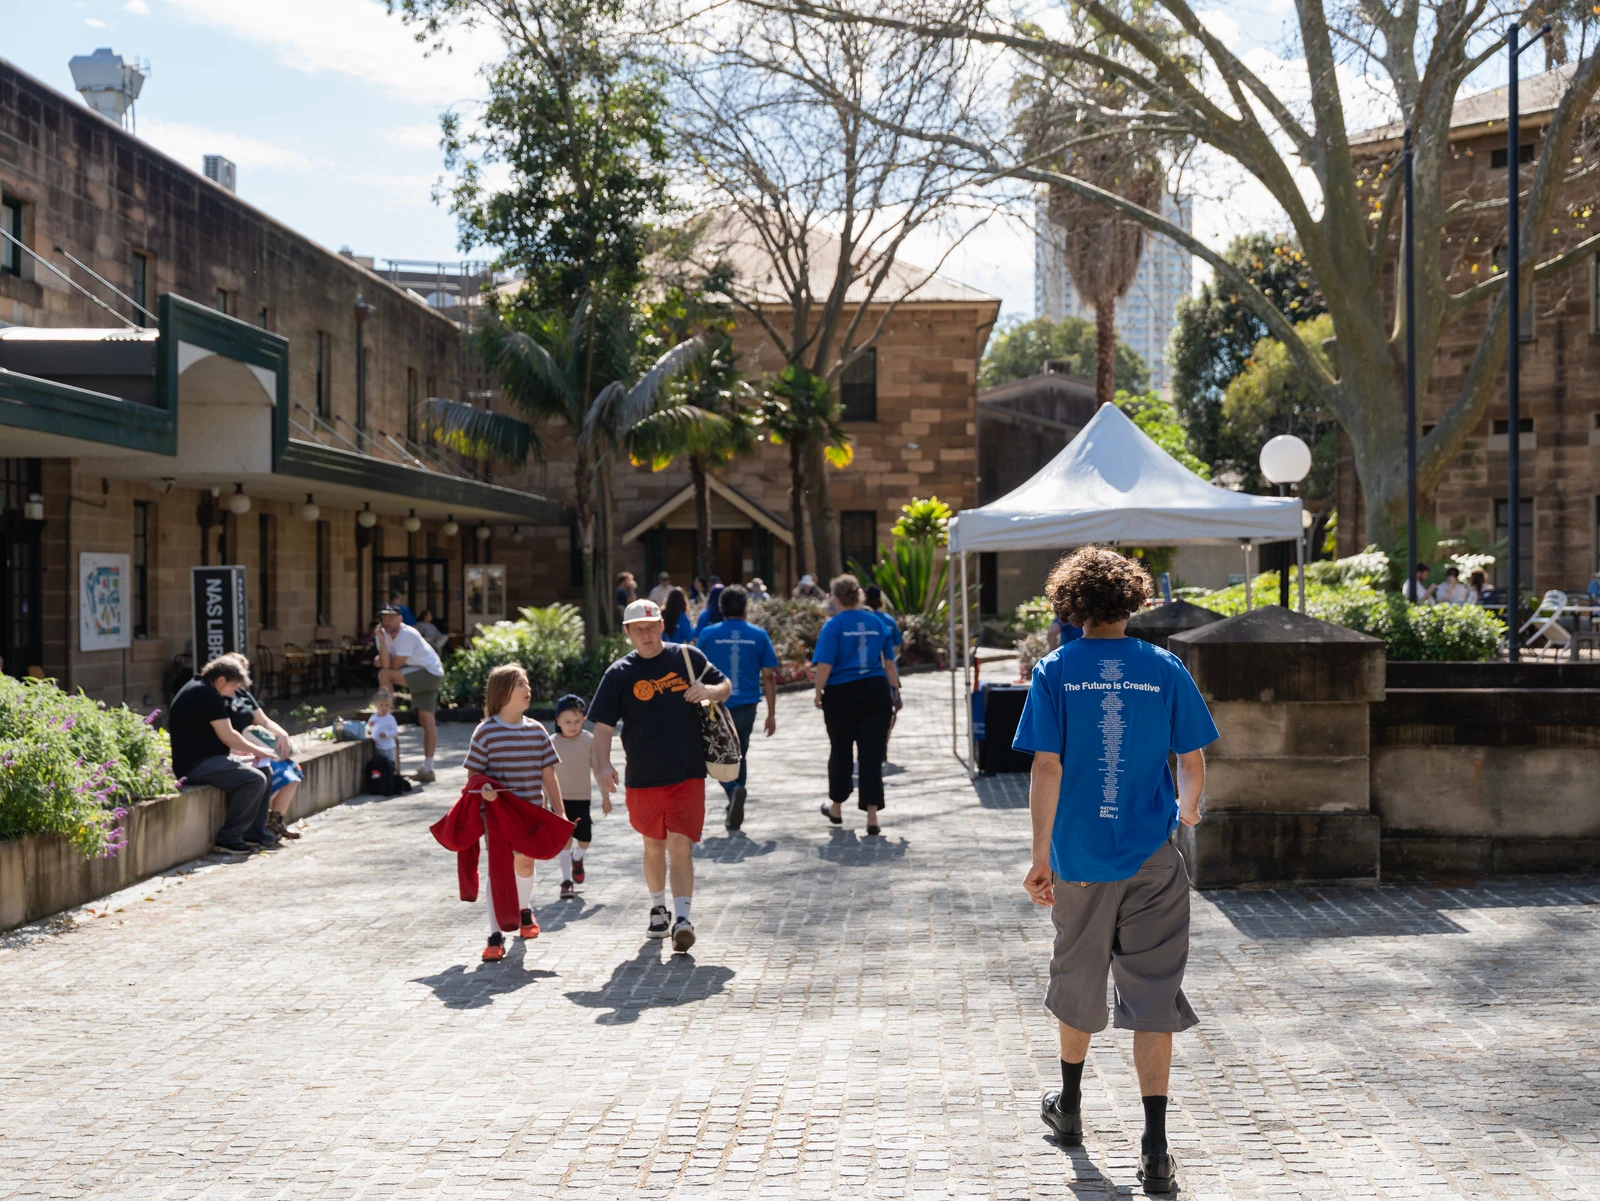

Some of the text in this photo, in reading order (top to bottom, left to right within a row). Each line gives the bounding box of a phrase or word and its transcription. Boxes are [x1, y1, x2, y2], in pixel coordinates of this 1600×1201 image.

[206, 578, 224, 617] NAS
[1063, 680, 1160, 693] The Future is Creative
